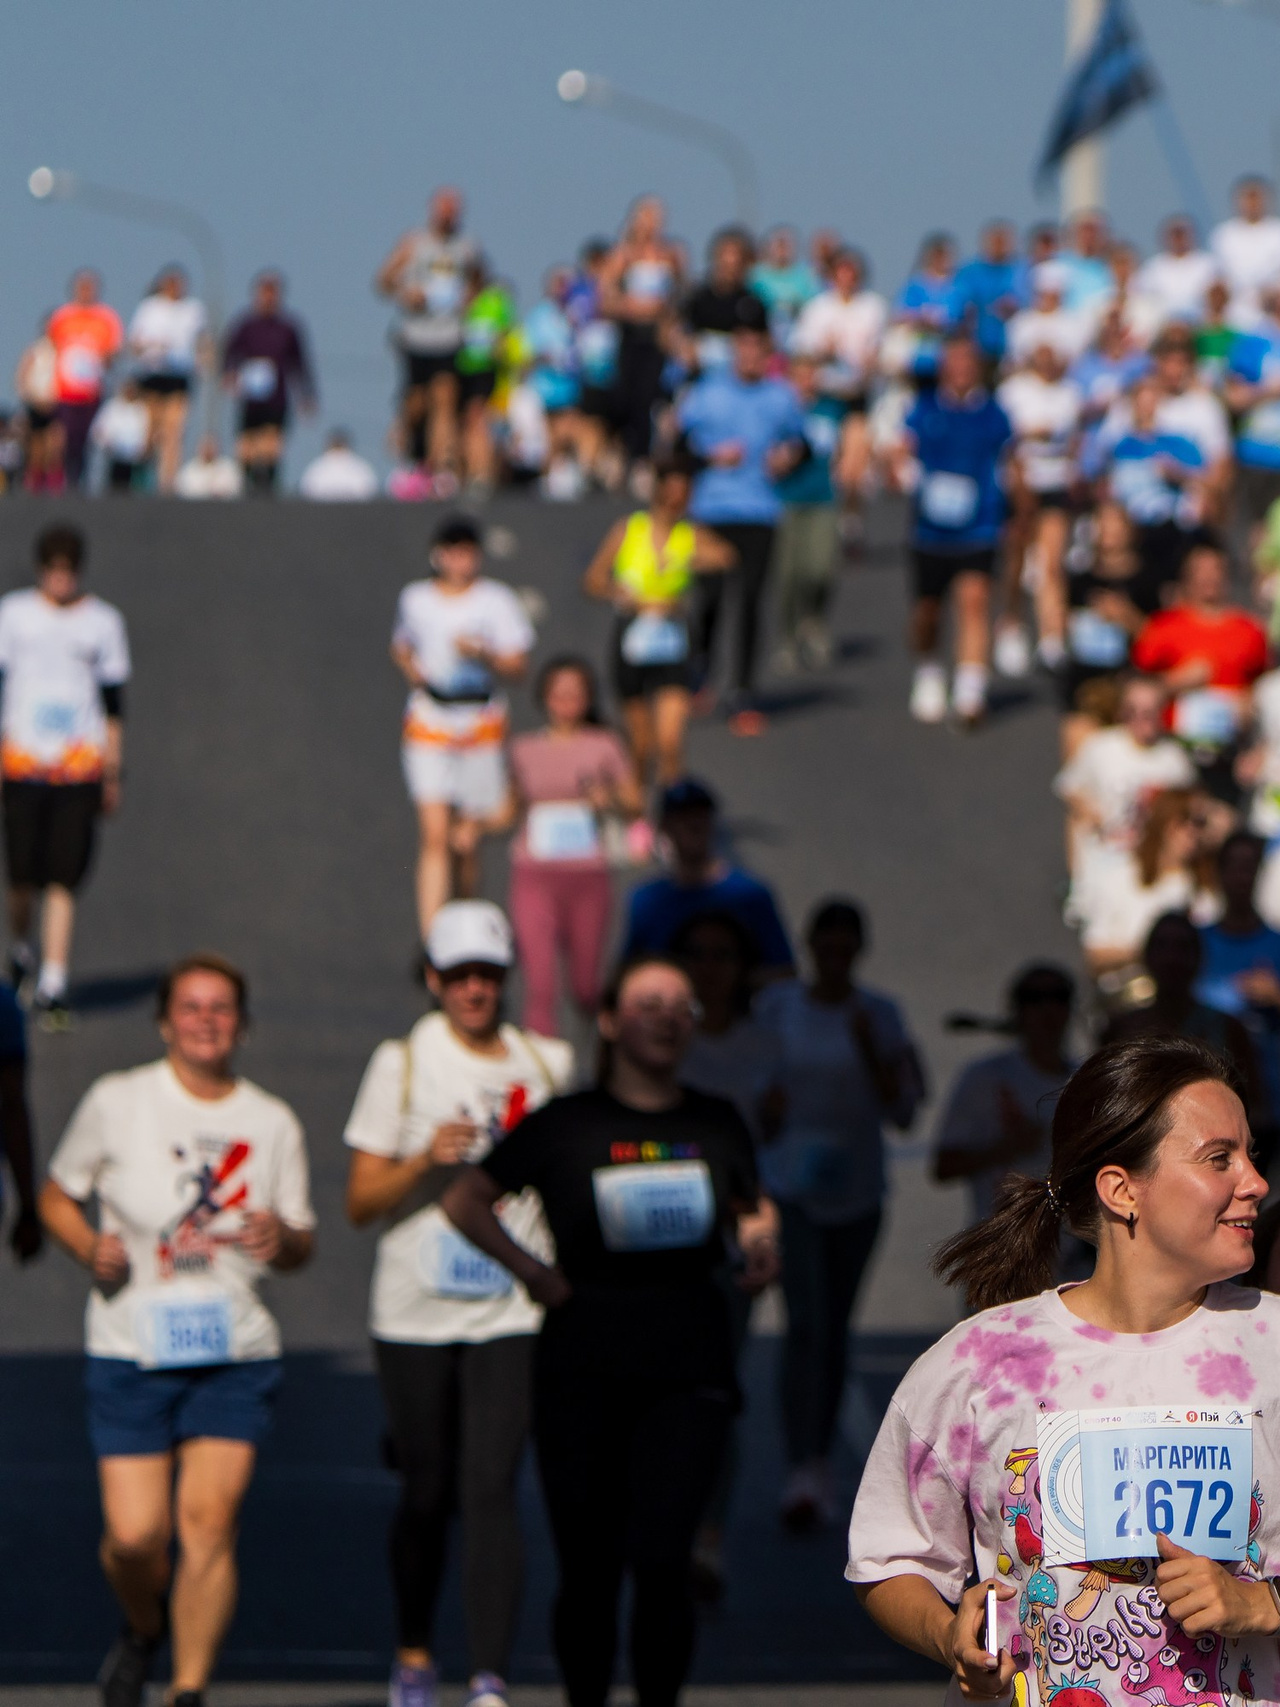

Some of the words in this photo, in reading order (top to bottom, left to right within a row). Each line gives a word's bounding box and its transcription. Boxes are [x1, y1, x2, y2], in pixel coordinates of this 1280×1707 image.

[1201, 1411, 1219, 1422] Пэй
[1114, 1446, 1232, 1471] МАРГАРИТА
[1114, 1479, 1234, 1539] 2672
